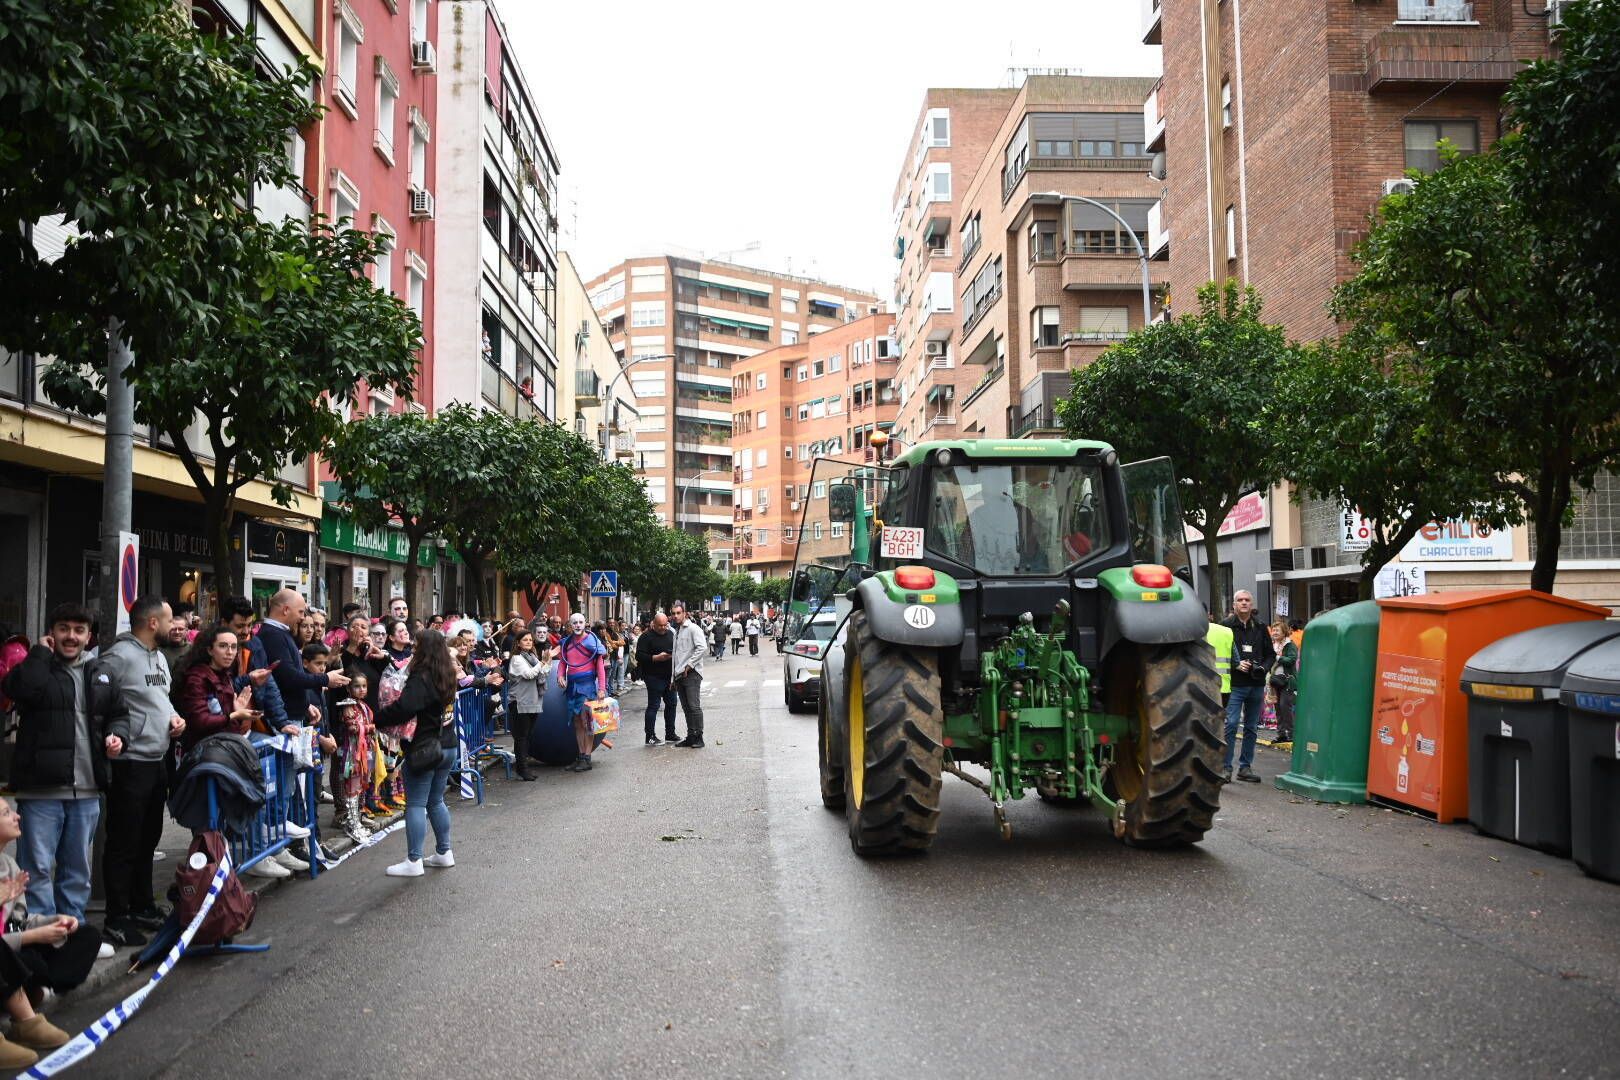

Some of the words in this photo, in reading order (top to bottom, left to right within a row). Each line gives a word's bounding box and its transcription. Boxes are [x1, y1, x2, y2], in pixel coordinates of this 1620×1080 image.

[353, 521, 388, 552] FARMACIA
[883, 529, 921, 543] E4231
[1420, 519, 1492, 541] EMILIO
[174, 533, 187, 552] DE
[888, 543, 914, 556] BGH
[1420, 546, 1493, 557] CHARCUTERIA
[912, 607, 929, 626] 40
[144, 674, 167, 687] PUMA
